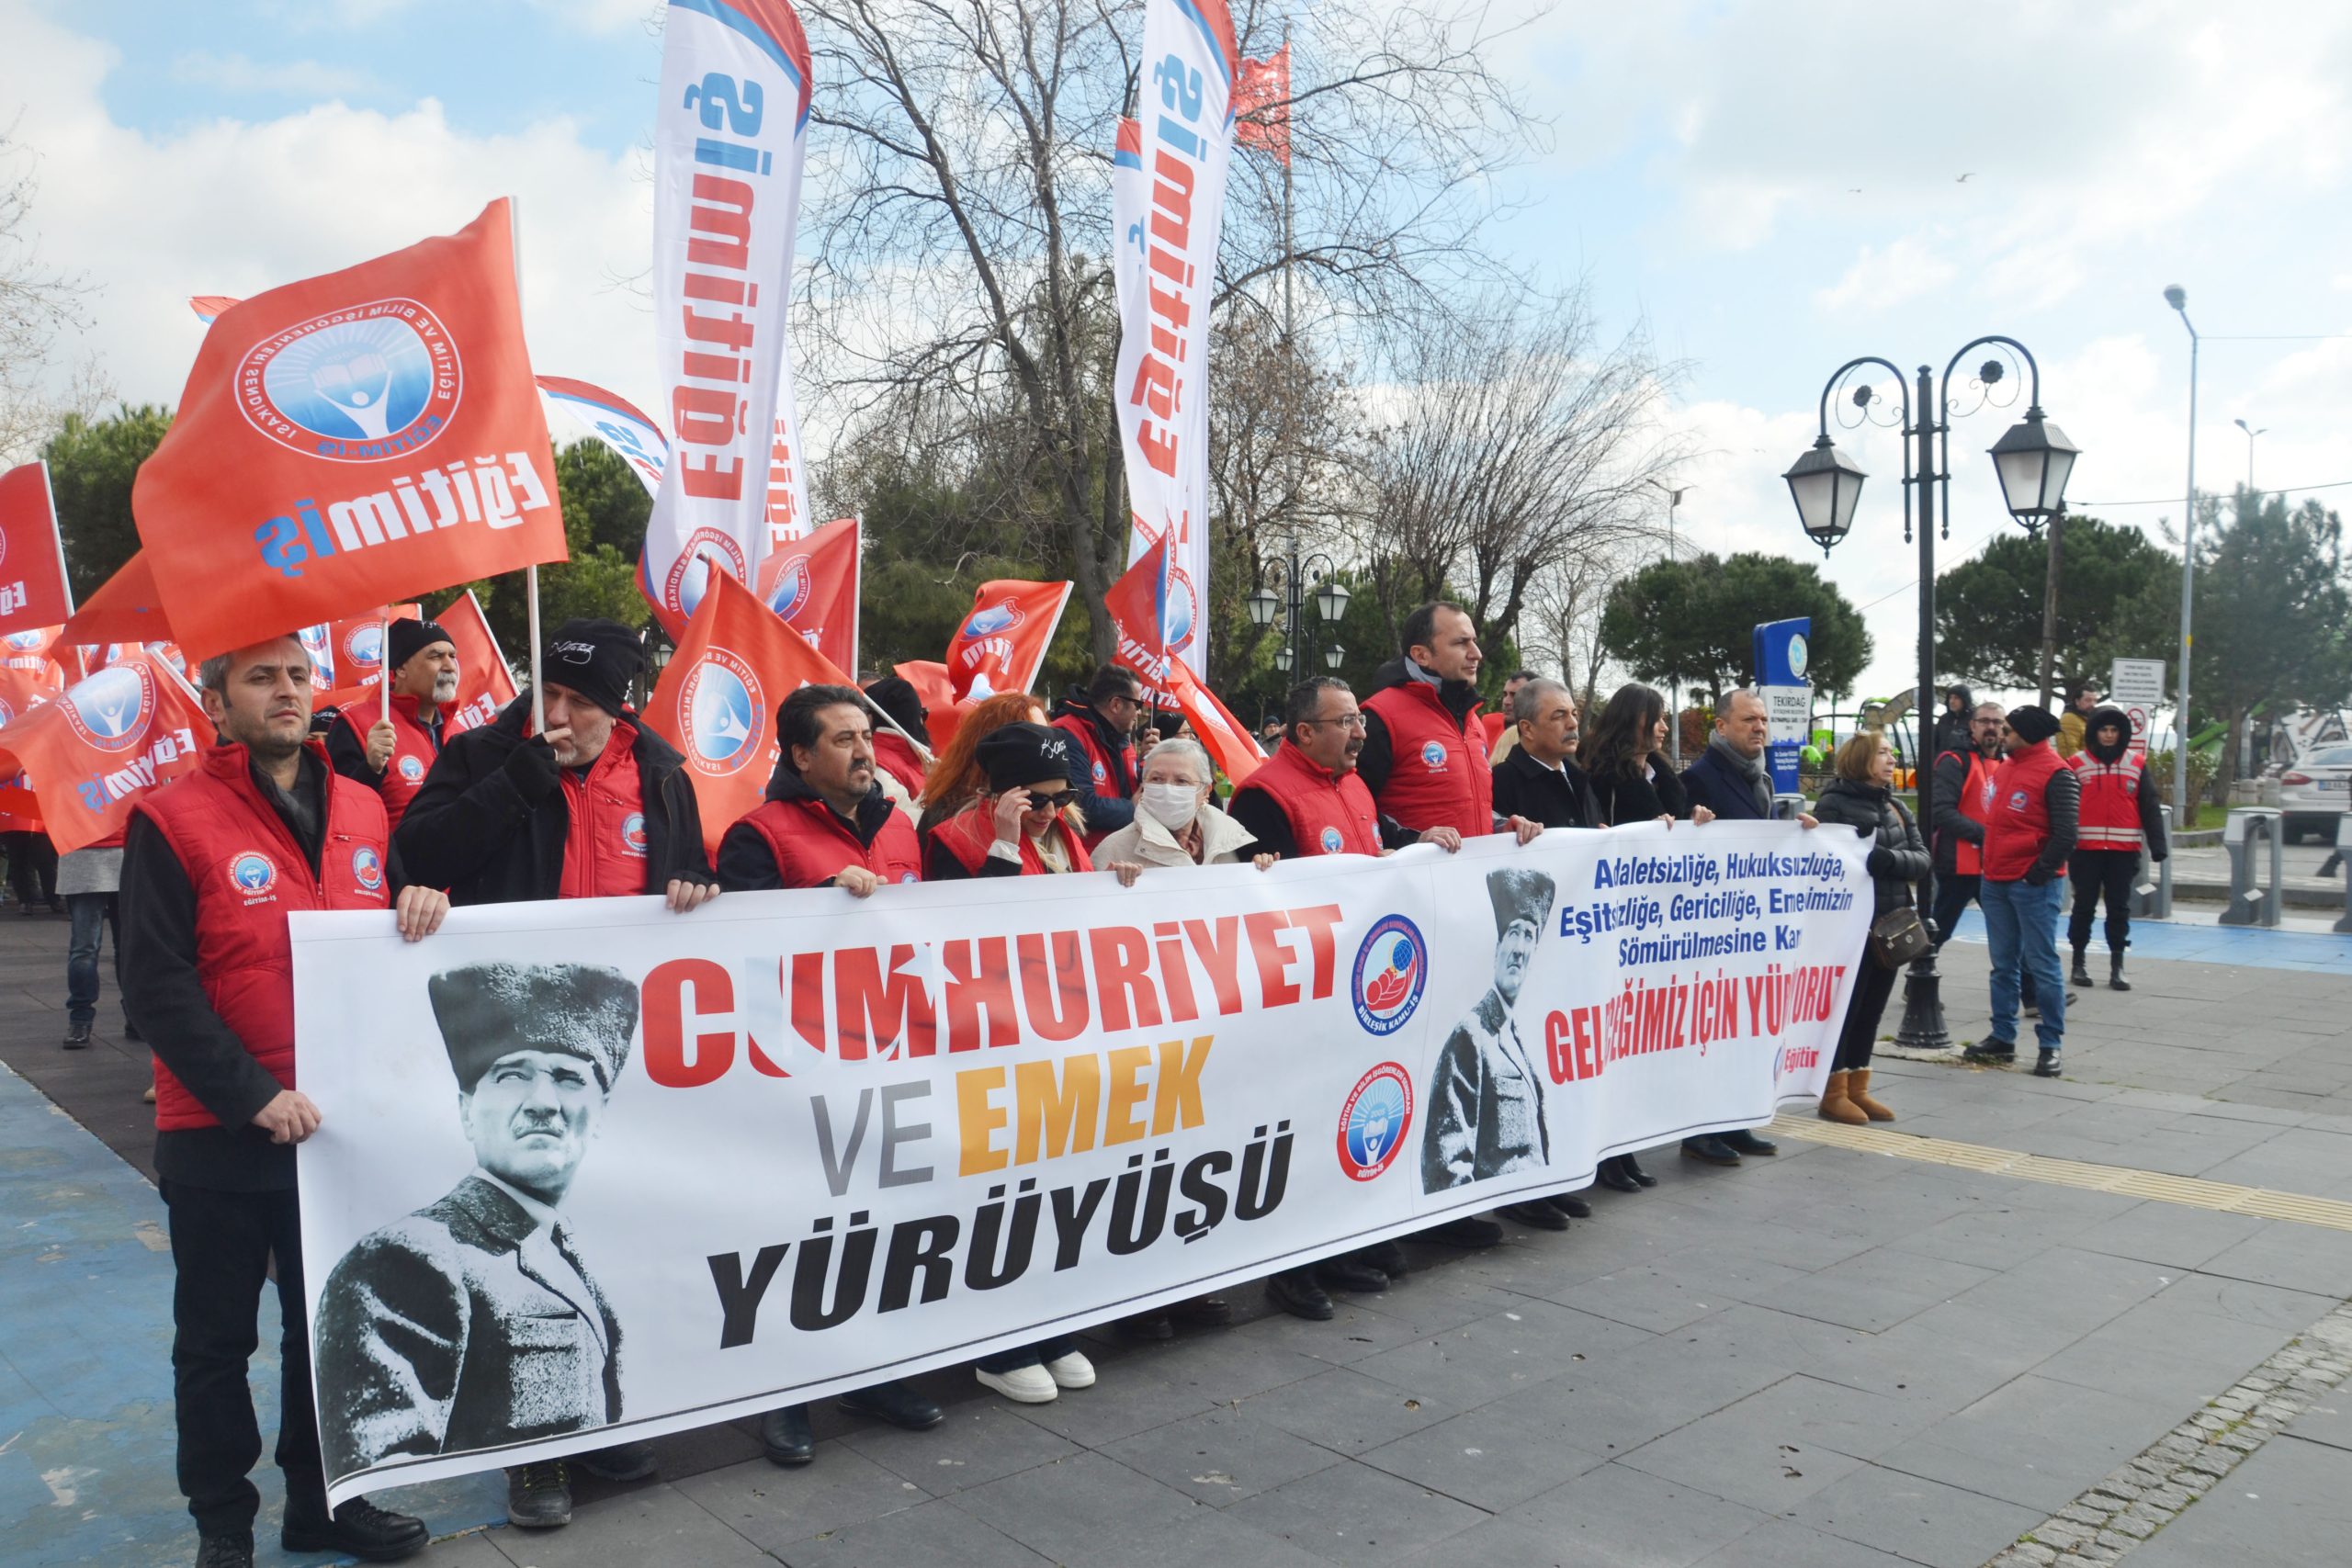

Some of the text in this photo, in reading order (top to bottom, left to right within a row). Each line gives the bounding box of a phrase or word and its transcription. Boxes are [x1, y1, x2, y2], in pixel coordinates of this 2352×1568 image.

[1773, 694, 1806, 707] TEKİRDAĞ
[1594, 852, 1846, 890] Adaletsizliğe, Hukuksuzluğa,
[1670, 887, 1761, 922] Gericiliğe,
[1619, 926, 1767, 968] Sömürülmesine
[1358, 1004, 1387, 1032] BİRLEŞİK
[1690, 967, 1739, 1057] İÇİN
[809, 1034, 1215, 1197] VE EMEK
[707, 1119, 1295, 1350] YÜRÜYÜŞÜ
